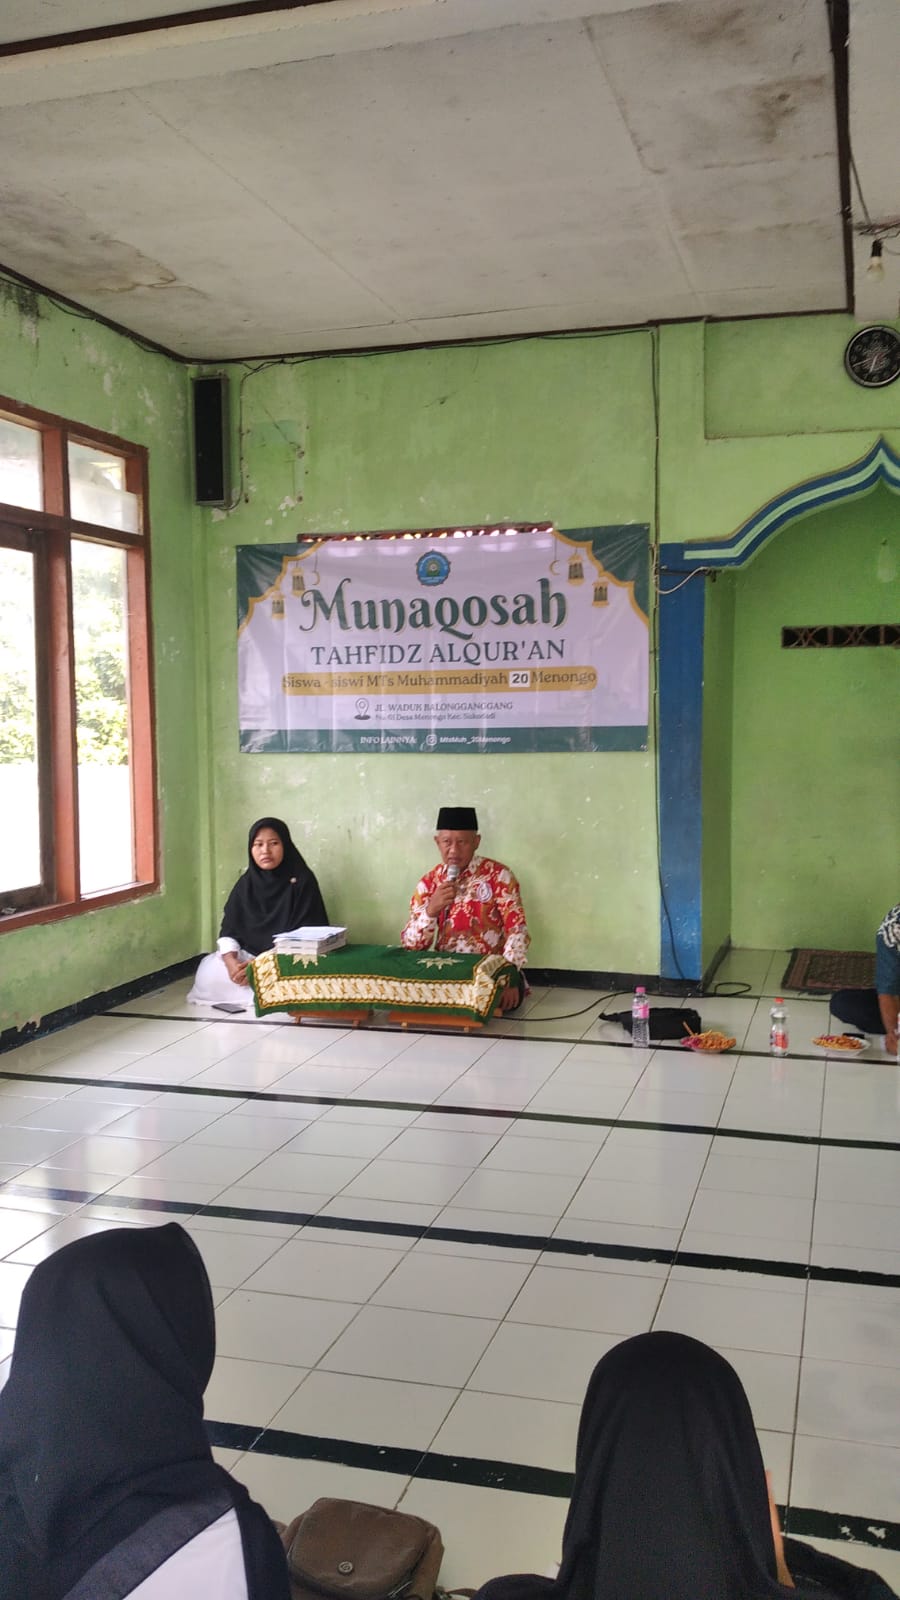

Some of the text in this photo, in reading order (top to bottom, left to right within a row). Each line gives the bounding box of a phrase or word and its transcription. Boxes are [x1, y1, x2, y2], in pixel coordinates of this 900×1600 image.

[299, 578, 567, 640] Munaqosah
[311, 640, 565, 666] TAHFIDZ ALQUR'AN
[282, 676, 320, 688] Siswa
[331, 675, 364, 687] siswi
[367, 675, 394, 687] MTs
[397, 672, 507, 688] Muhammadiyah
[511, 673, 529, 684] 20
[532, 671, 597, 685] Menongo
[388, 703, 421, 712] WADUK
[360, 736, 379, 744] INFO
